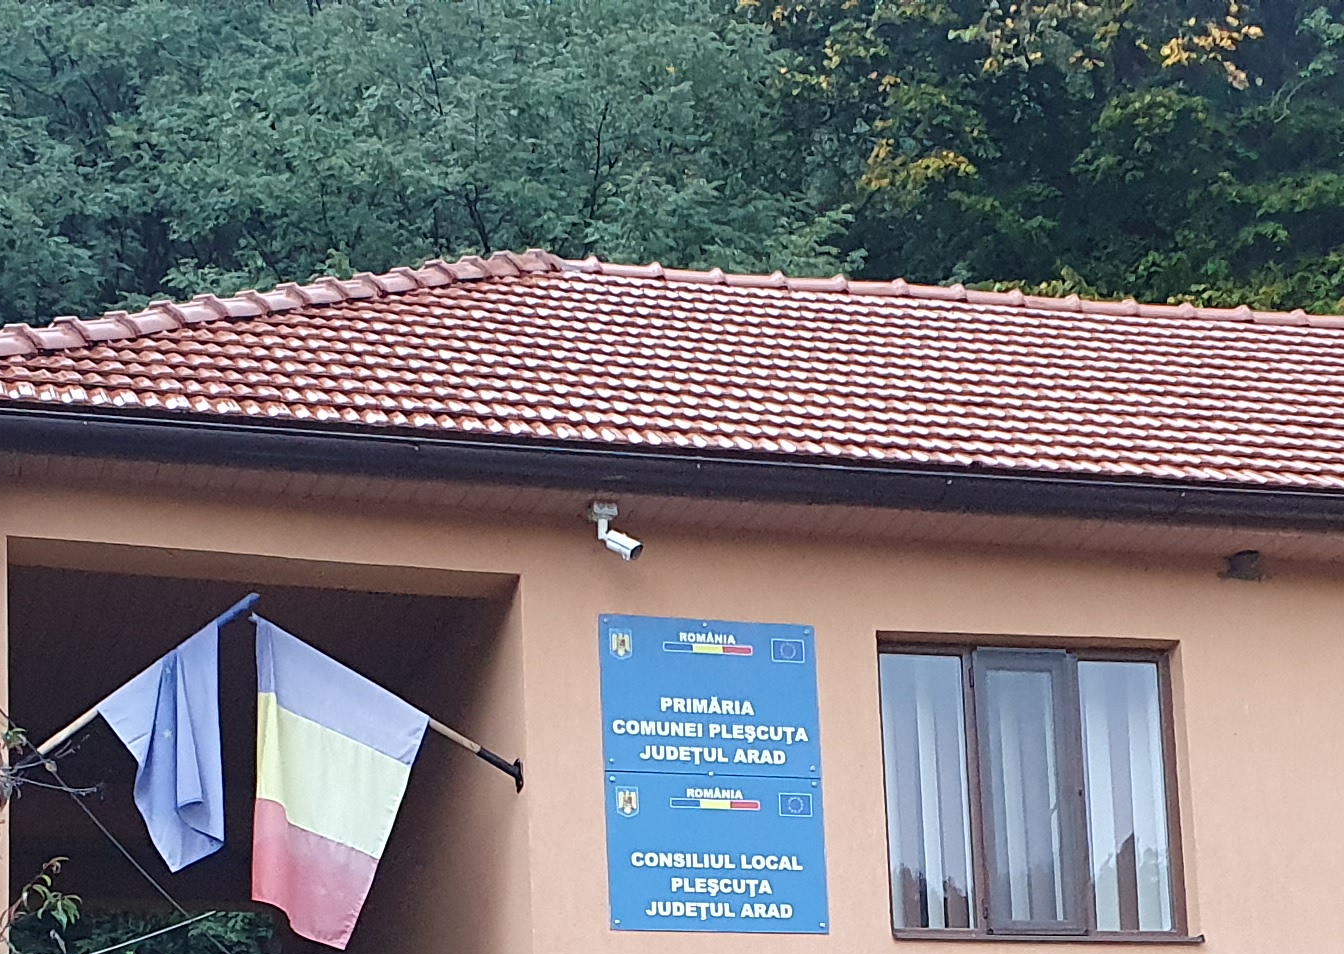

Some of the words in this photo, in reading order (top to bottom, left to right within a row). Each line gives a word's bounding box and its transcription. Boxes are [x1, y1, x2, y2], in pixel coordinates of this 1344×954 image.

[679, 631, 736, 645] ROMÂNIA
[660, 696, 754, 716] PRIMĂRIA
[612, 719, 703, 738] COMUNEI
[733, 749, 786, 765] ARAD
[686, 786, 743, 800] ROMÂNIA
[630, 851, 736, 869] CONSILIUL
[740, 854, 803, 871] LOCAL
[740, 903, 793, 919] ARAD
